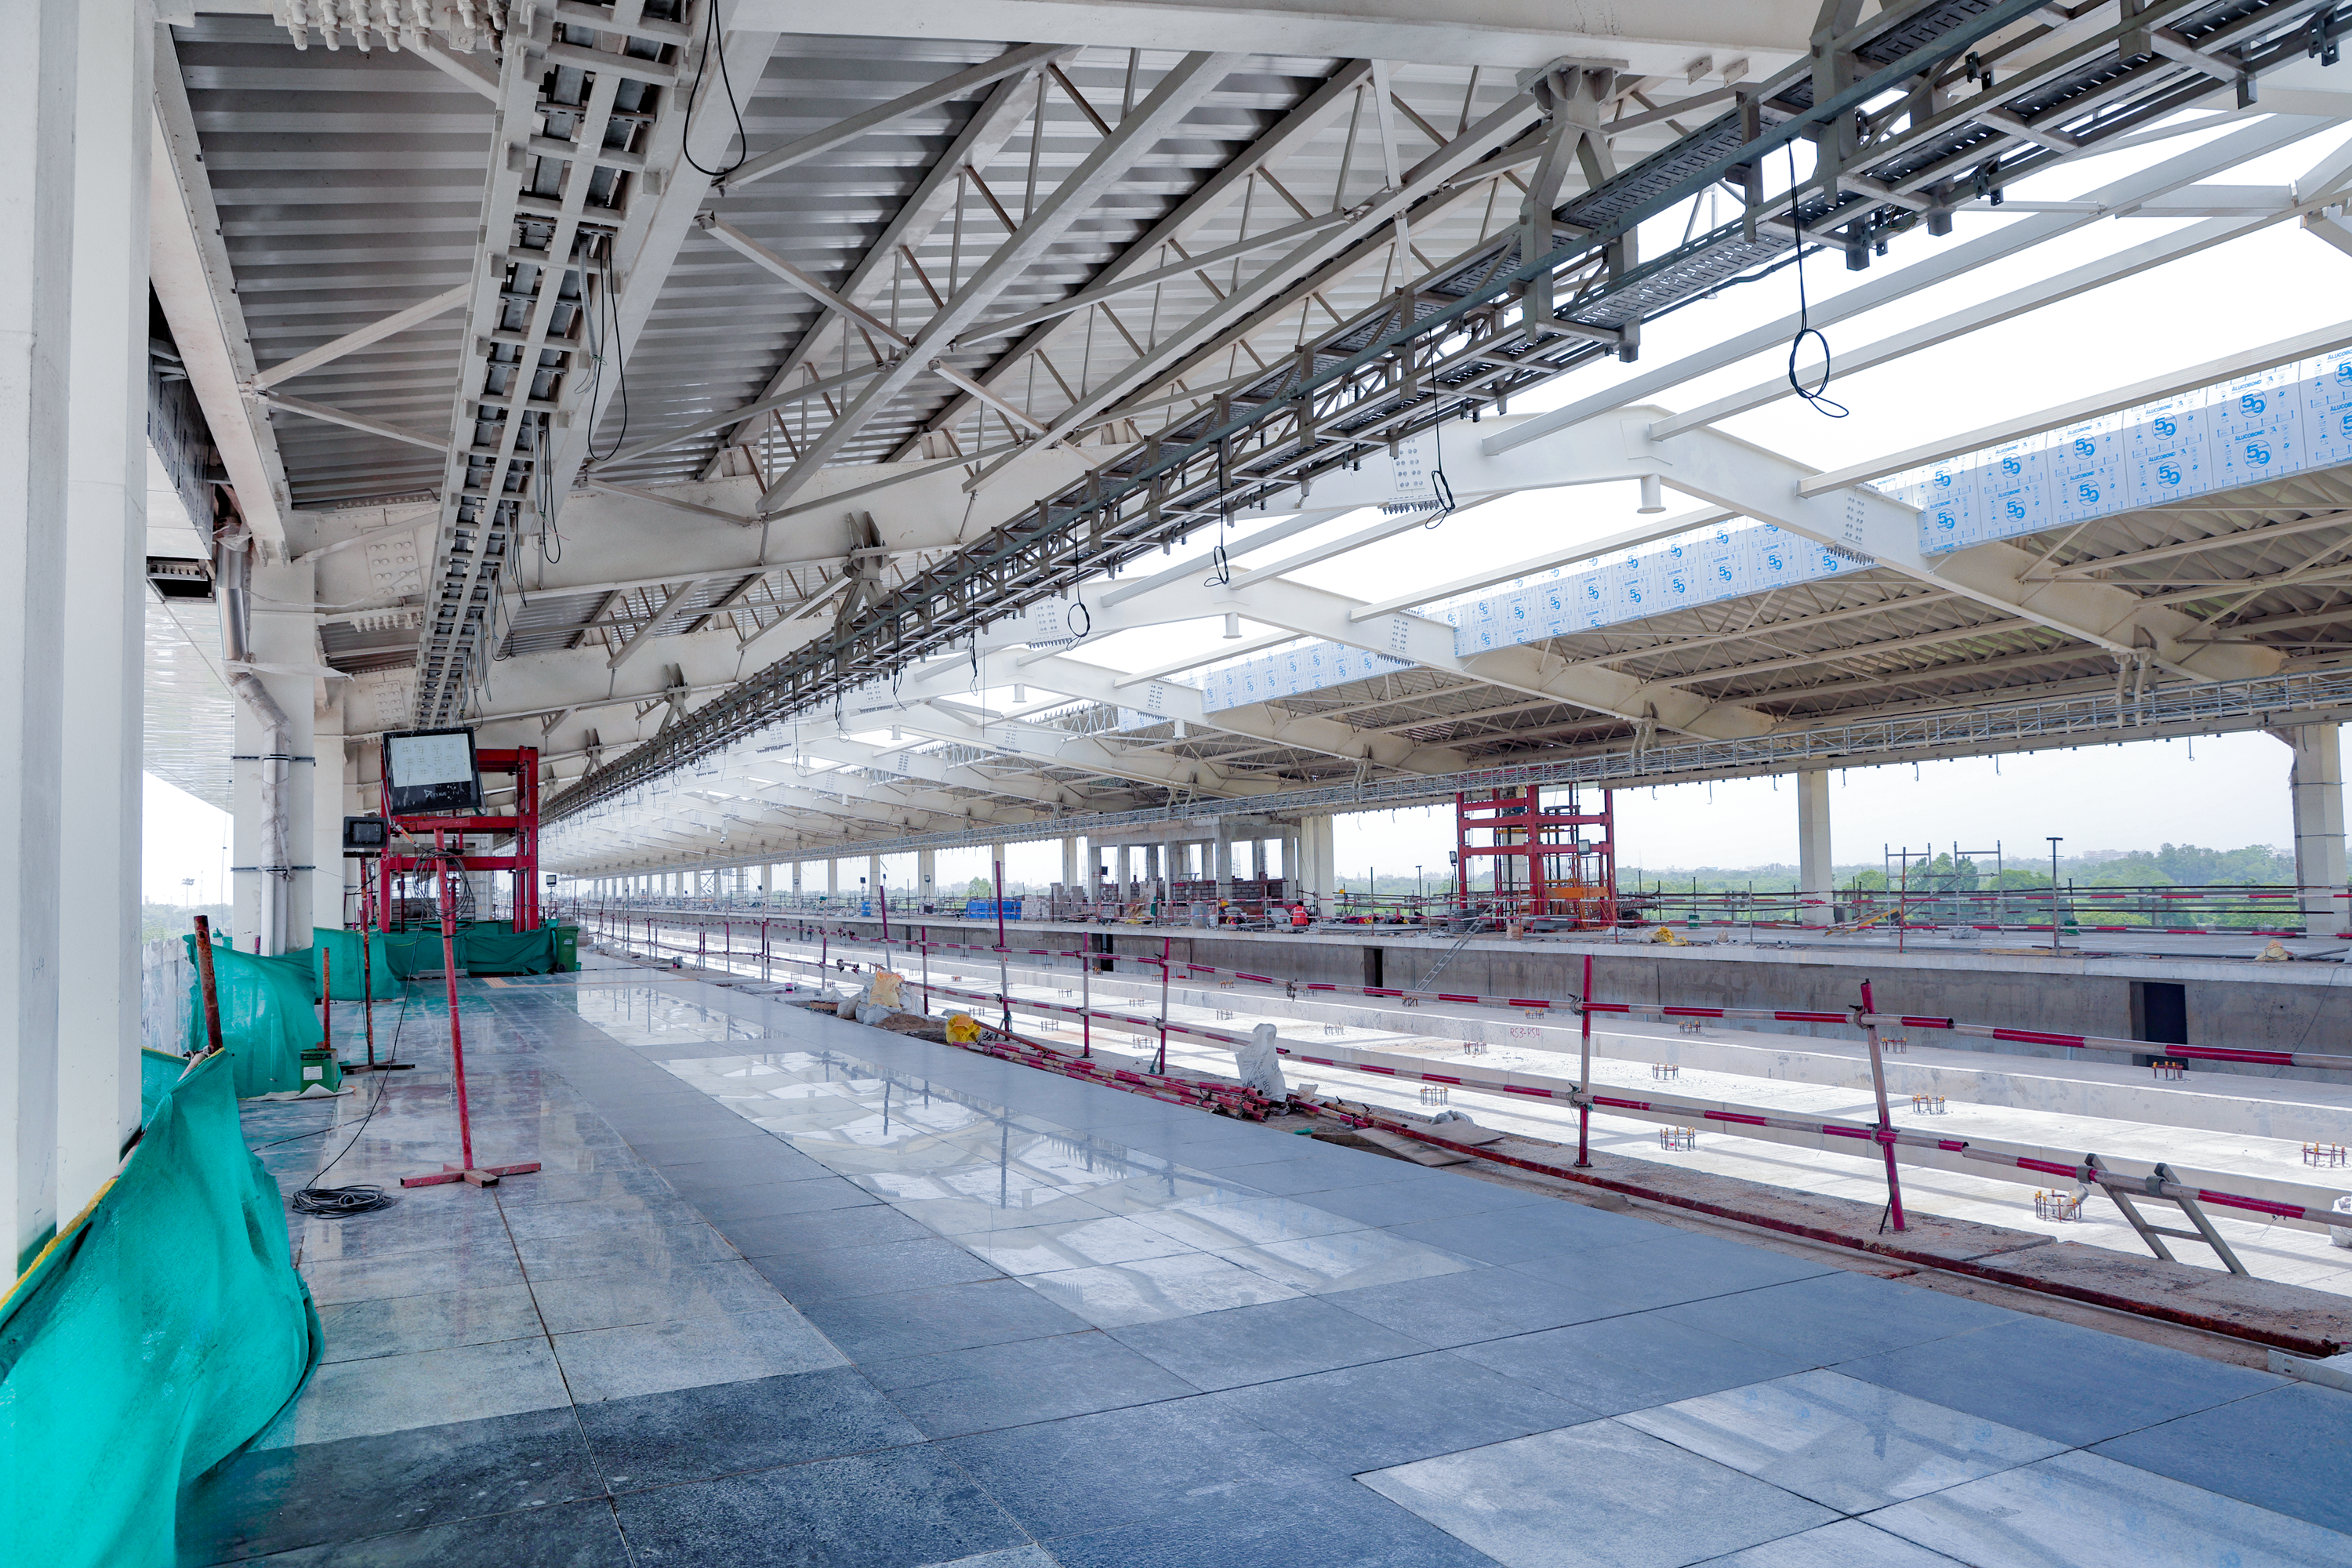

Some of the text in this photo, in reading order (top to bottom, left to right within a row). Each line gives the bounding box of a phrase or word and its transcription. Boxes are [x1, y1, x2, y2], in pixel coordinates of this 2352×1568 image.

[2232, 379, 2262, 391] ALUCOBOND
[2146, 404, 2172, 415] ALUCOBOND
[2242, 394, 2265, 413] 50
[2067, 425, 2092, 435] ALUCOBOND
[2154, 417, 2176, 436] 50
[2235, 430, 2265, 441] ALUCOBOND
[1995, 445, 2019, 455] ALUCOBOND
[2076, 437, 2095, 456] 50
[2247, 445, 2270, 464] 50
[2148, 452, 2176, 462] ALUCOBOND
[2003, 457, 2021, 474] 50
[1935, 470, 1951, 486] 50
[2070, 471, 2095, 481] ALUCOBOND
[2159, 465, 2180, 485] 50
[1998, 488, 2020, 498] ALUCOBOND
[2080, 484, 2100, 502] 50
[2007, 501, 2025, 519] 50
[1938, 512, 1955, 529] 50
[1769, 555, 1782, 570] 50
[1823, 555, 1838, 571] 50
[1719, 566, 1732, 581] 50
[1673, 579, 1685, 593] 50
[1263, 1079, 1273, 1097] FOR
